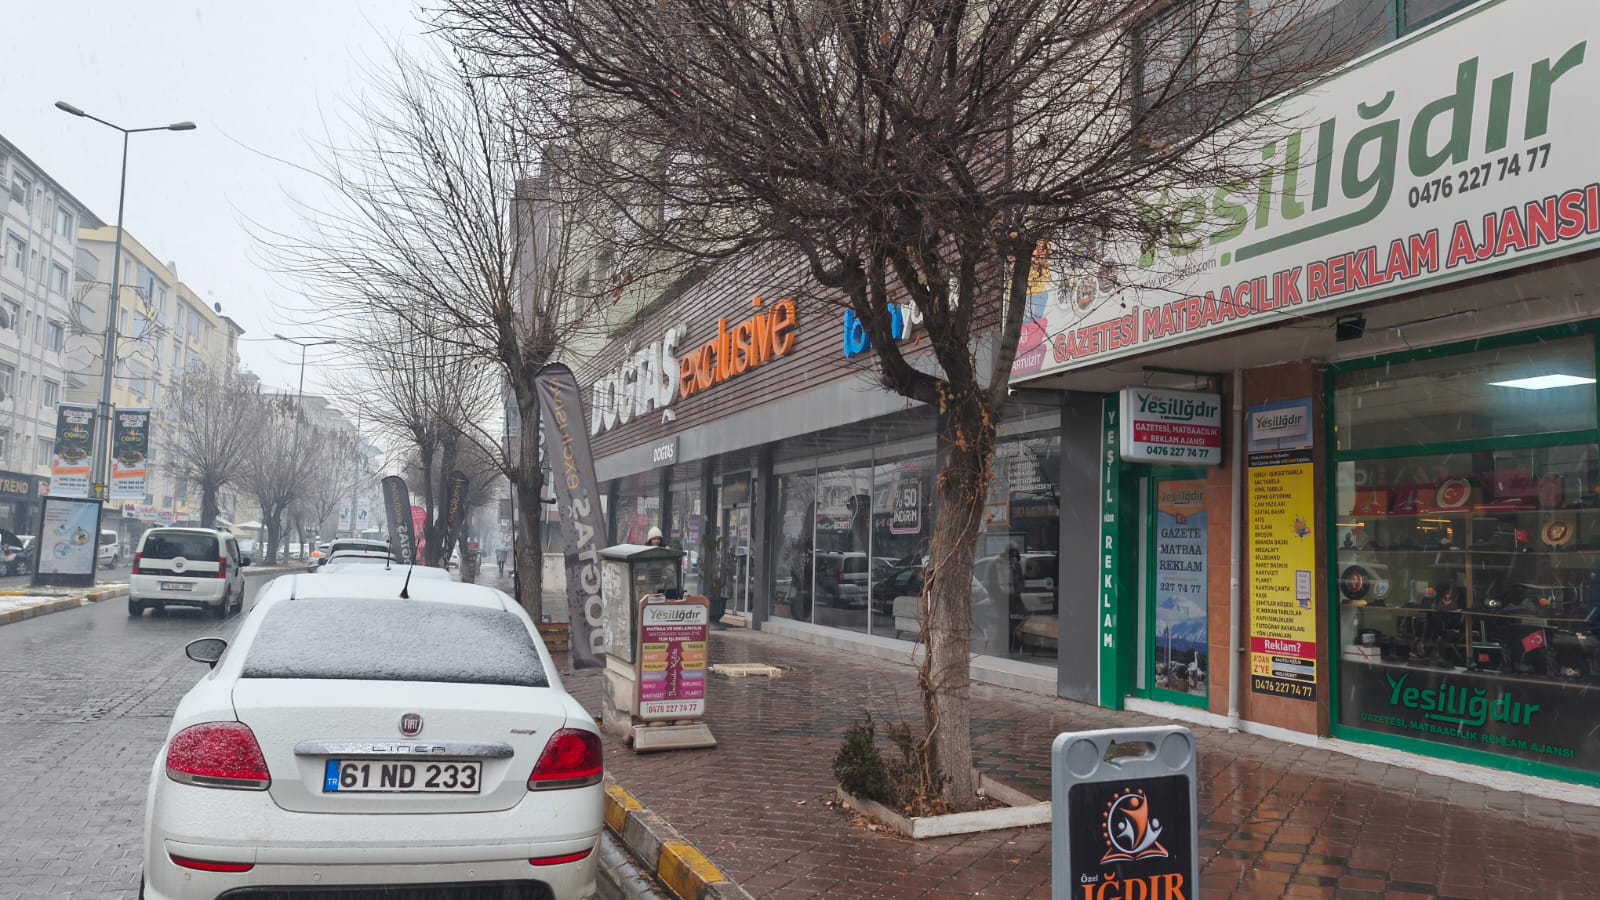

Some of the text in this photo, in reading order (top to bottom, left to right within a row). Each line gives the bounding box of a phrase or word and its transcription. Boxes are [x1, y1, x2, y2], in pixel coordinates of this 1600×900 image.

[1408, 143, 1553, 208] 0476 227 74 77
[1052, 183, 1600, 364] GAZETESİ MATBAACILIK REKLAM AJANSI
[591, 322, 687, 436] DOĞTAŞ
[679, 295, 795, 398] exclusive
[1151, 435, 1206, 446] REKLAM AJANSI
[1146, 446, 1209, 458] 0476 227 74 77
[1161, 528, 1202, 539] GAZETE
[1160, 544, 1202, 556] MATBAA
[1160, 560, 1203, 572] REKLAM
[1103, 535, 1114, 648] REKLAM
[1160, 582, 1201, 593] 227 74 77
[1264, 640, 1302, 652] Reklam?
[1256, 680, 1312, 697] 0476 227 74 77
[648, 704, 664, 714] 0476
[666, 704, 678, 712] 227
[404, 719, 418, 730] FIAT
[1481, 734, 1528, 750] REKLAM
[1530, 742, 1576, 759] AJANSI
[341, 764, 370, 788] 61
[380, 764, 416, 788] ND
[425, 765, 478, 788] 233
[1080, 874, 1098, 883] Özel
[1080, 872, 1186, 900] IĞDIR
